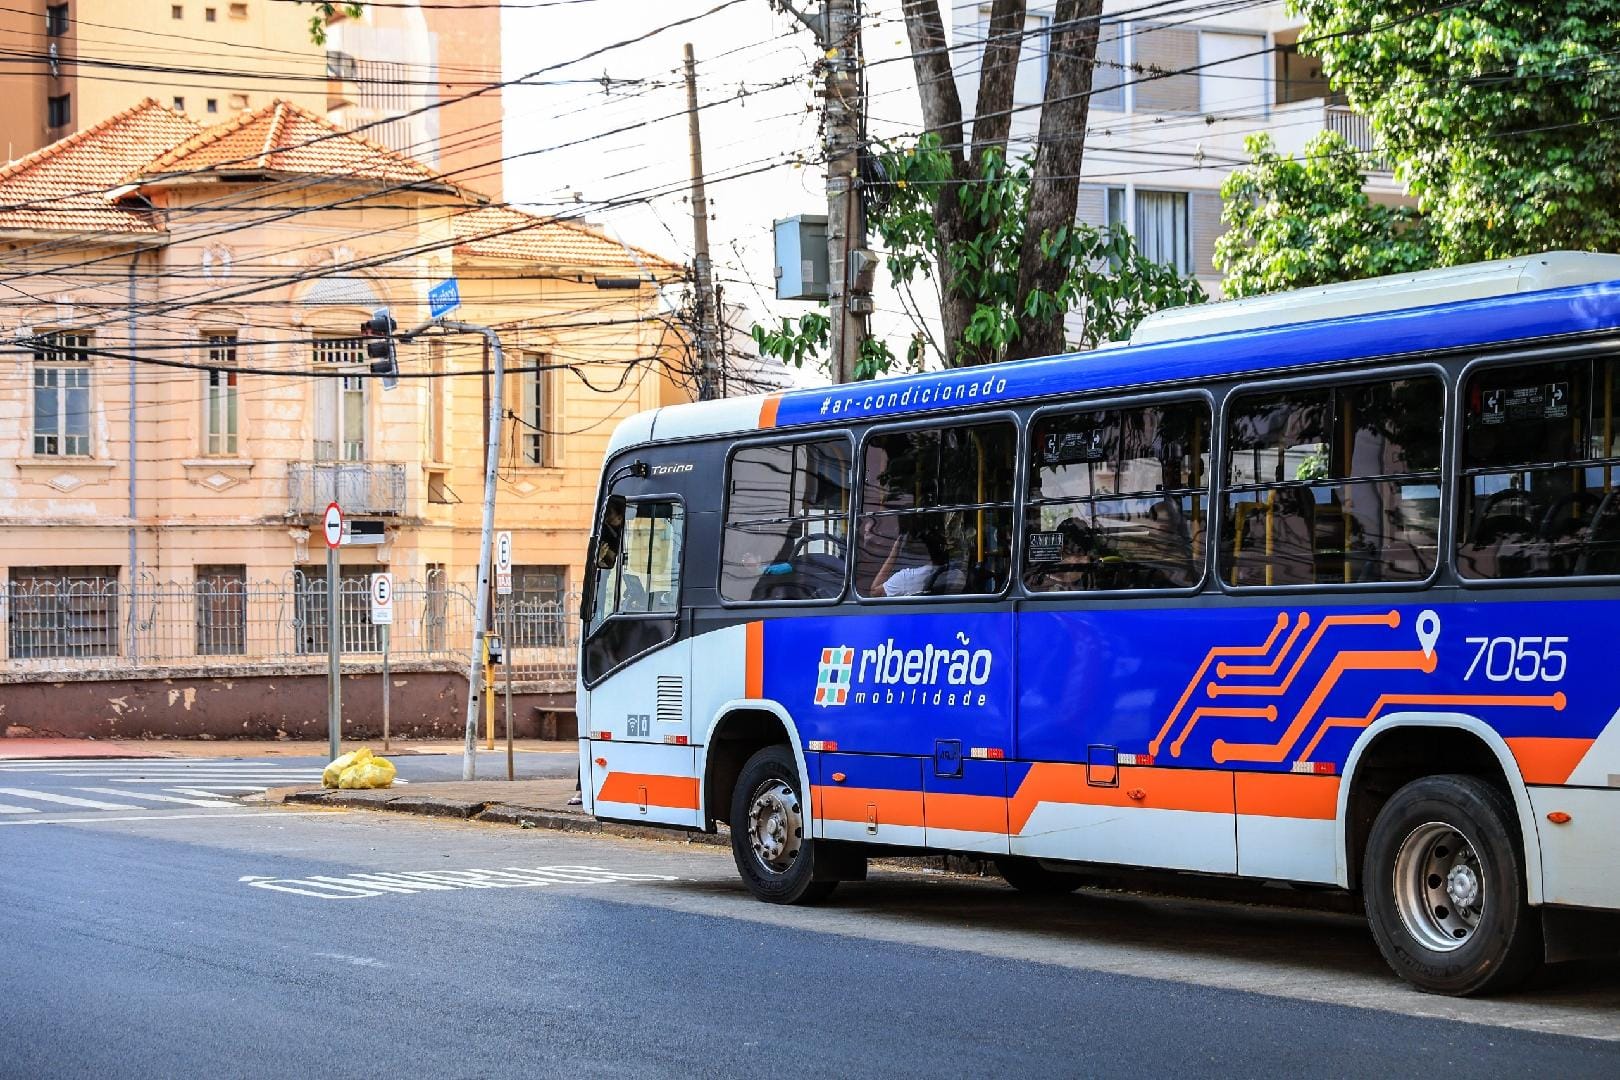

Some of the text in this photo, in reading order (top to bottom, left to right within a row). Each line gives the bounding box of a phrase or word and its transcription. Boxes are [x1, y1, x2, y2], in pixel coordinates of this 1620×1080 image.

[819, 374, 1007, 416] #ar-condicionado
[651, 463, 694, 475] Torino
[501, 540, 508, 564] E
[378, 581, 386, 599] E
[858, 631, 992, 685] ribeirão
[1463, 636, 1569, 682] 7055
[855, 688, 987, 706] mobilidade
[238, 865, 680, 899] ÔNIBUS
